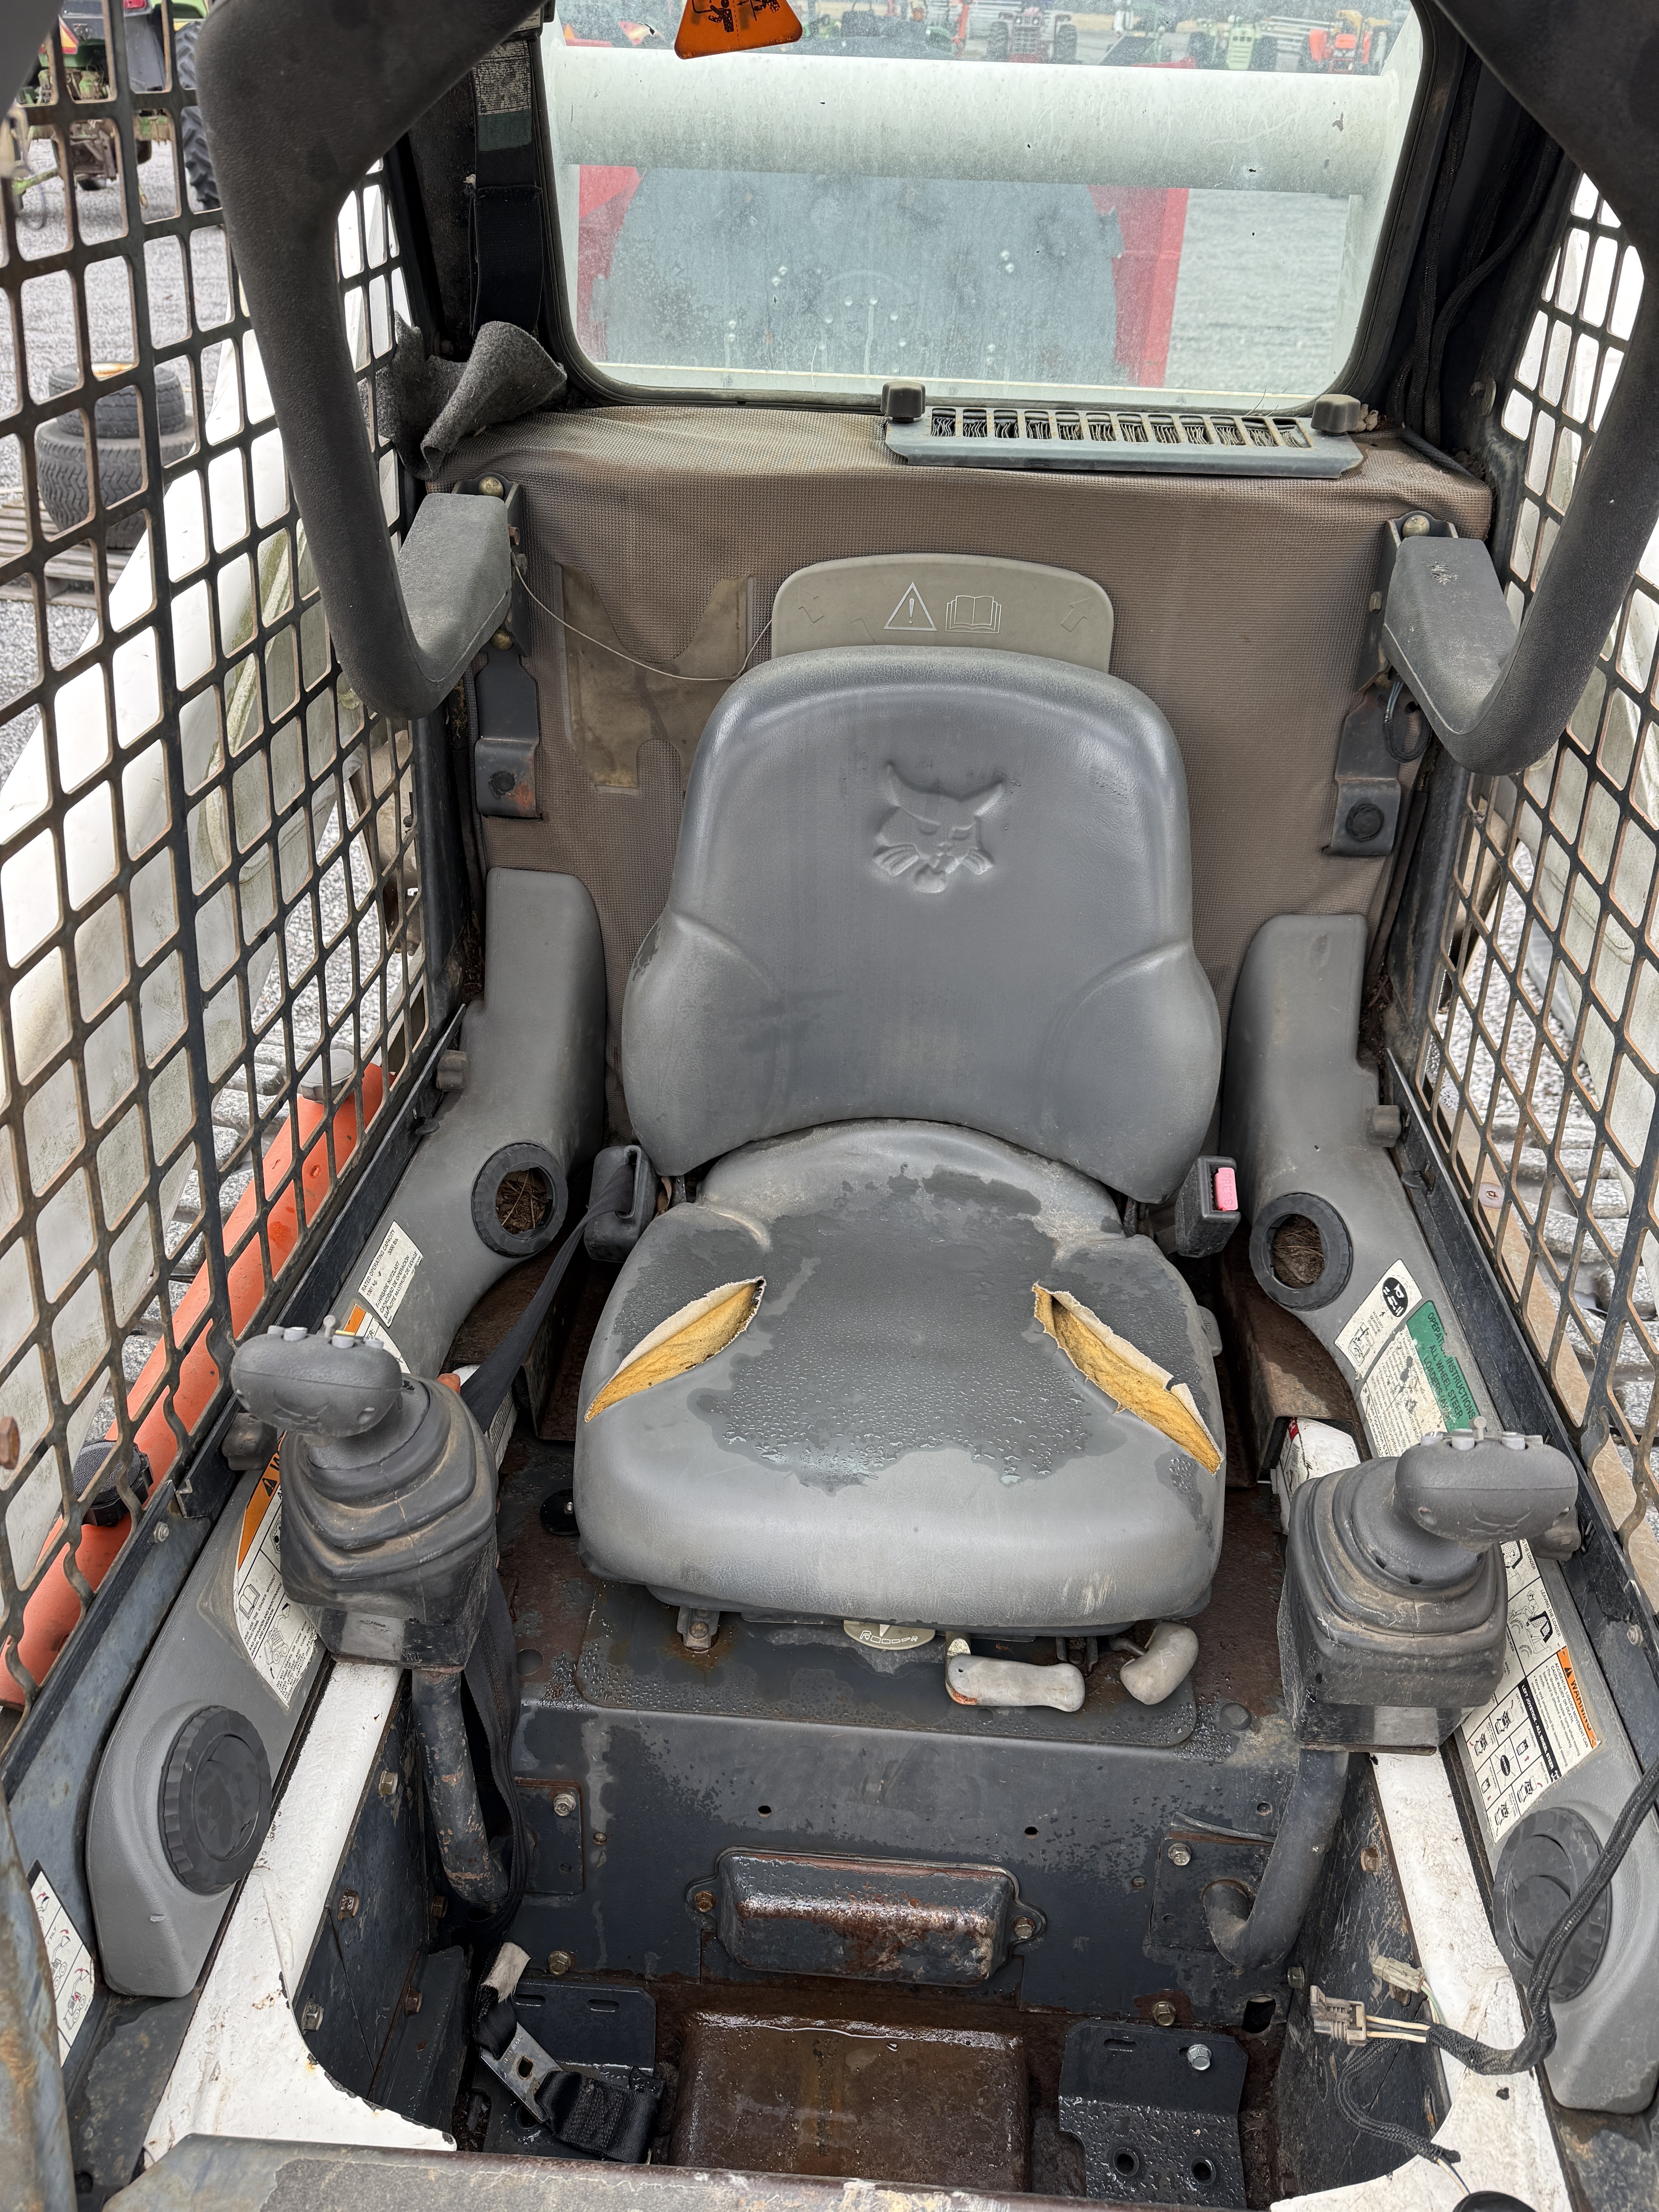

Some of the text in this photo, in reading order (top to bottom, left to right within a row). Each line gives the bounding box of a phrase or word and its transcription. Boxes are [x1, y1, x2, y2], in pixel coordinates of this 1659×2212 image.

[361, 1228, 395, 1293] RATED OPERATING CAPACITY
[407, 1250, 418, 1269] LEVAGE
[375, 1260, 400, 1308] FAHRBARE NUTZLAST
[379, 1286, 394, 1314] CAPACIDAD
[1423, 1356, 1444, 1396] LOADERS
[1428, 1343, 1465, 1420] ALL WHEEL STEER
[1444, 1356, 1477, 1420] INSTRUCTIONS
[1373, 1414, 1384, 1445] Operation
[1526, 1552, 1536, 1570] LOADER
[253, 1617, 265, 1642] OPERATION
[267, 1580, 282, 1611] MAINTENANCE
[257, 1592, 267, 1612] LOADER
[266, 1573, 276, 1594] WITHOUT
[1540, 1589, 1551, 1609] LEAVING
[1551, 1617, 1561, 1637] LOADER
[284, 1652, 292, 1670] TRAVEL
[295, 1652, 305, 1671] EXCEED
[295, 1656, 306, 1678] CAPACITY
[1542, 1671, 1552, 1693] backward
[1551, 1696, 1561, 1715] different
[1563, 1729, 1573, 1749] steering
[1549, 1676, 1558, 1696] direction
[1572, 1739, 1581, 1757] moving
[1550, 1665, 1574, 1724] CAUSE INJURY OR DEATH.
[1554, 1661, 1567, 1692] ACCIDENTAL
[1565, 1690, 1575, 1711] LOADER
[1572, 1710, 1584, 1738] MOVEMENT
[1525, 1697, 1537, 1723] JOYSTICK
[1539, 1734, 1548, 1754] WHEEL
[1545, 1752, 1554, 1770] STEER
[1528, 1728, 1537, 1748] FORWARD
[1539, 1708, 1550, 1731] operating.
[1541, 1699, 1553, 1724] understand
[1553, 1731, 1562, 1750] selected
[1559, 1748, 1568, 1767] steering
